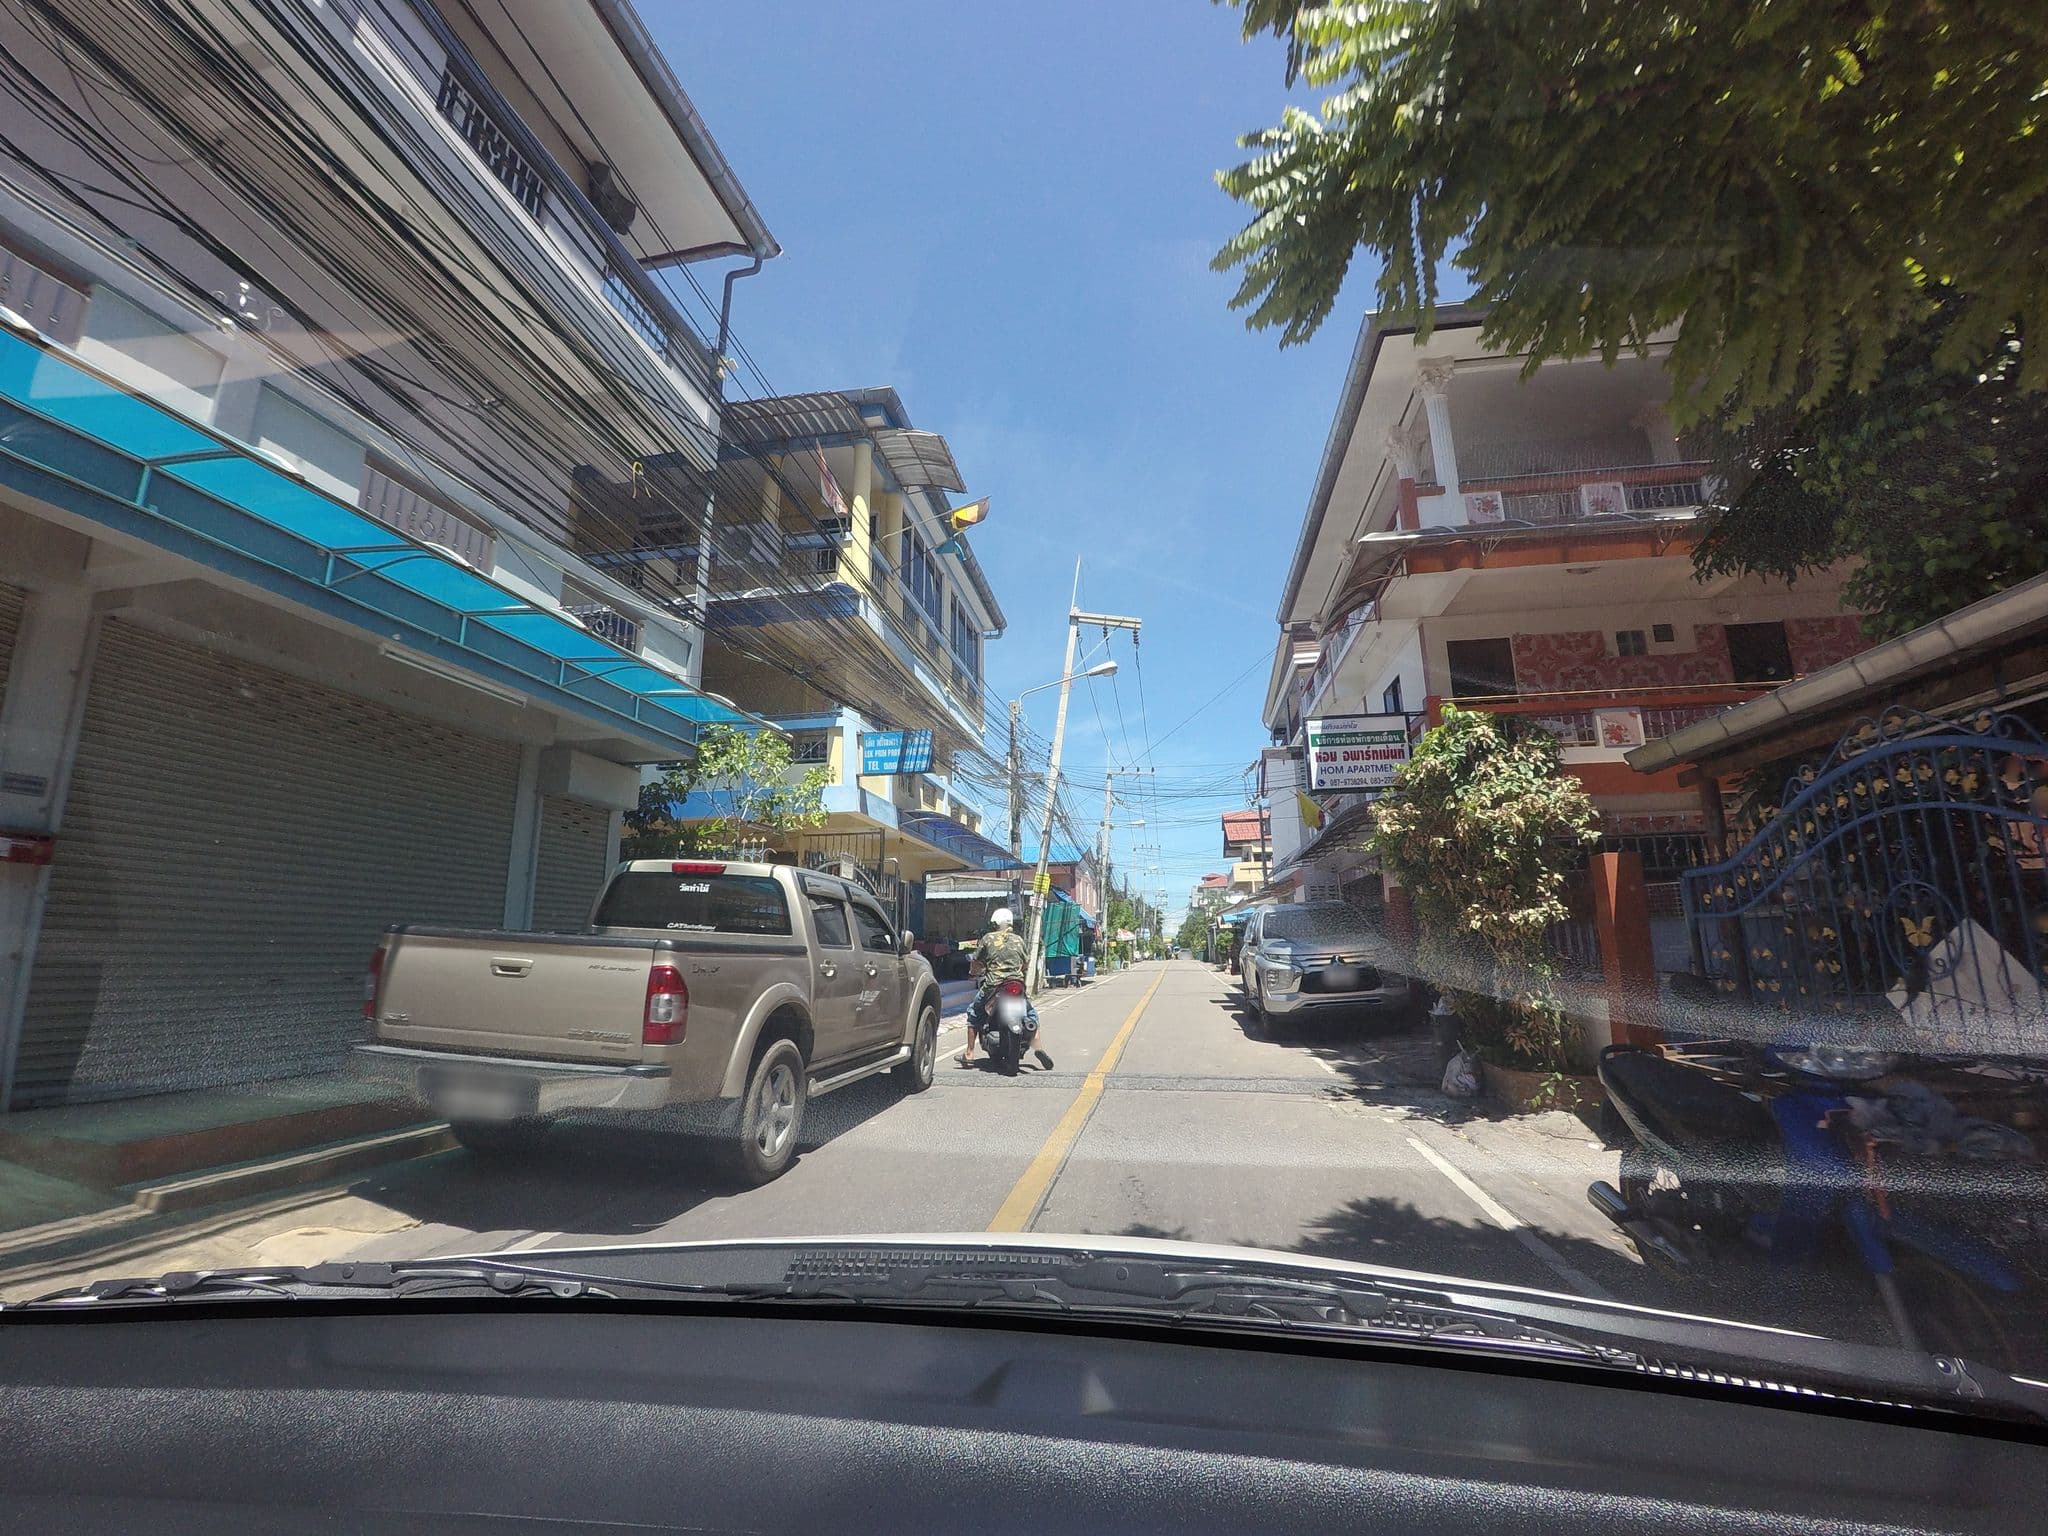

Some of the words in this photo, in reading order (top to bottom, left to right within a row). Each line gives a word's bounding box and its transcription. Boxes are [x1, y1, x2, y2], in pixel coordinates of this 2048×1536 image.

[1315, 750, 1338, 763] หอม
[868, 760, 880, 771] TEL
[1320, 765, 1344, 775] HOM
[1347, 763, 1395, 774] APARTMEN
